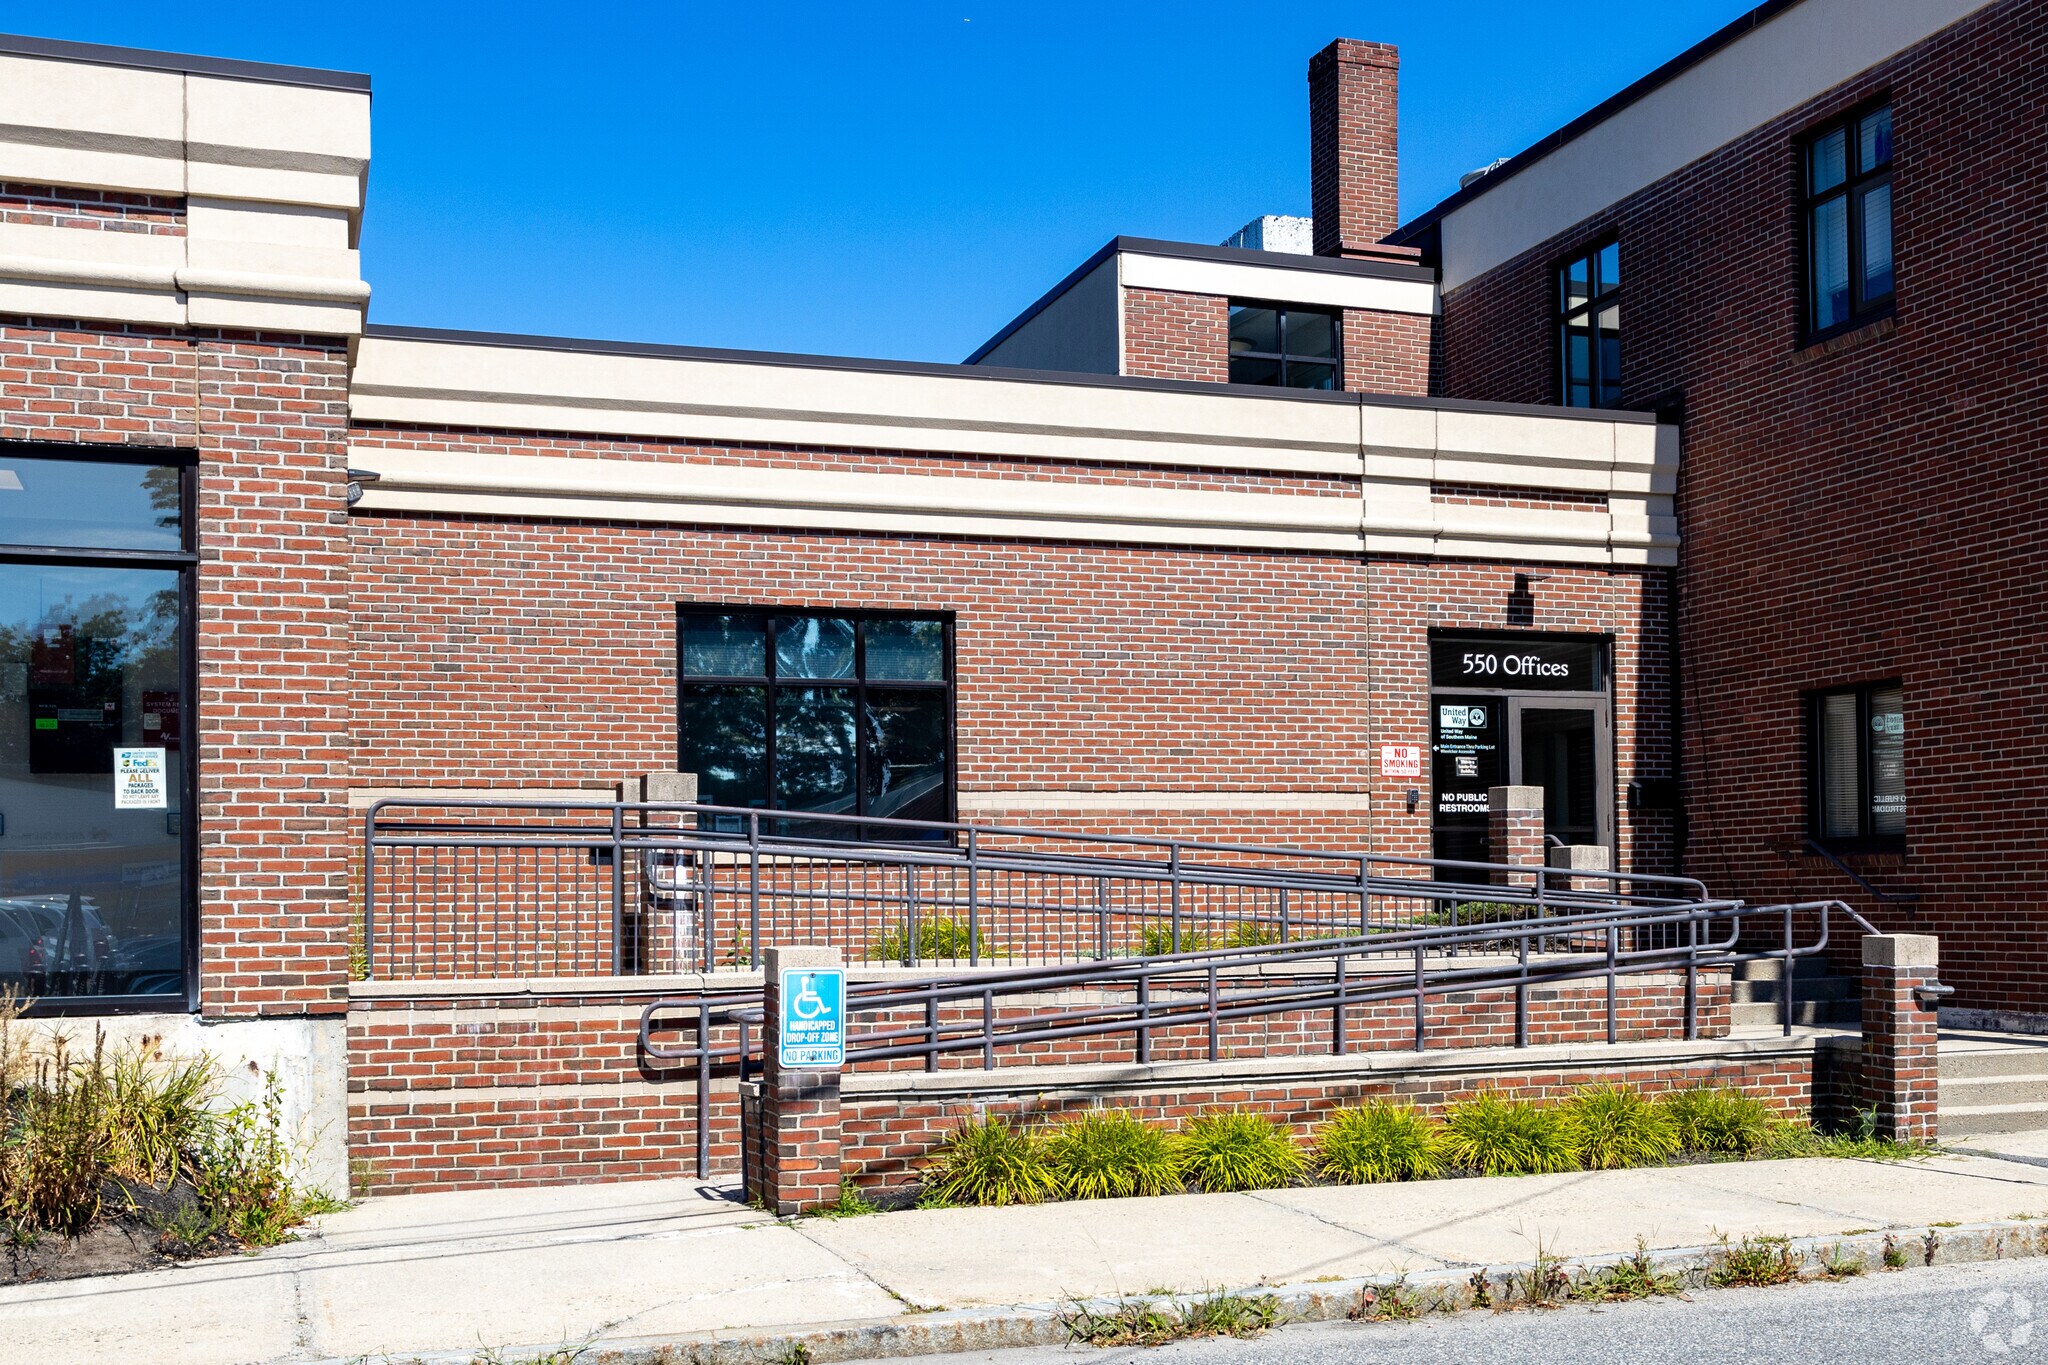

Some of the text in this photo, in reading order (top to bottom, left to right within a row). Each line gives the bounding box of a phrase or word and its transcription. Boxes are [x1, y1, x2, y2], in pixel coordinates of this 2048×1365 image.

[1463, 653, 1569, 676] 550 Offices
[1442, 707, 1467, 716] United
[1452, 716, 1467, 726] Way
[1394, 748, 1408, 758] NO
[133, 759, 157, 767] FedEx
[1384, 759, 1419, 768] SMOKING
[128, 773, 153, 782] ALL
[1441, 793, 1488, 802] NO PUBLIC
[789, 1020, 836, 1031] HANDICAPPED
[786, 1031, 839, 1043] DROP-OFF ZONE
[785, 1049, 838, 1061] NO PARKING
